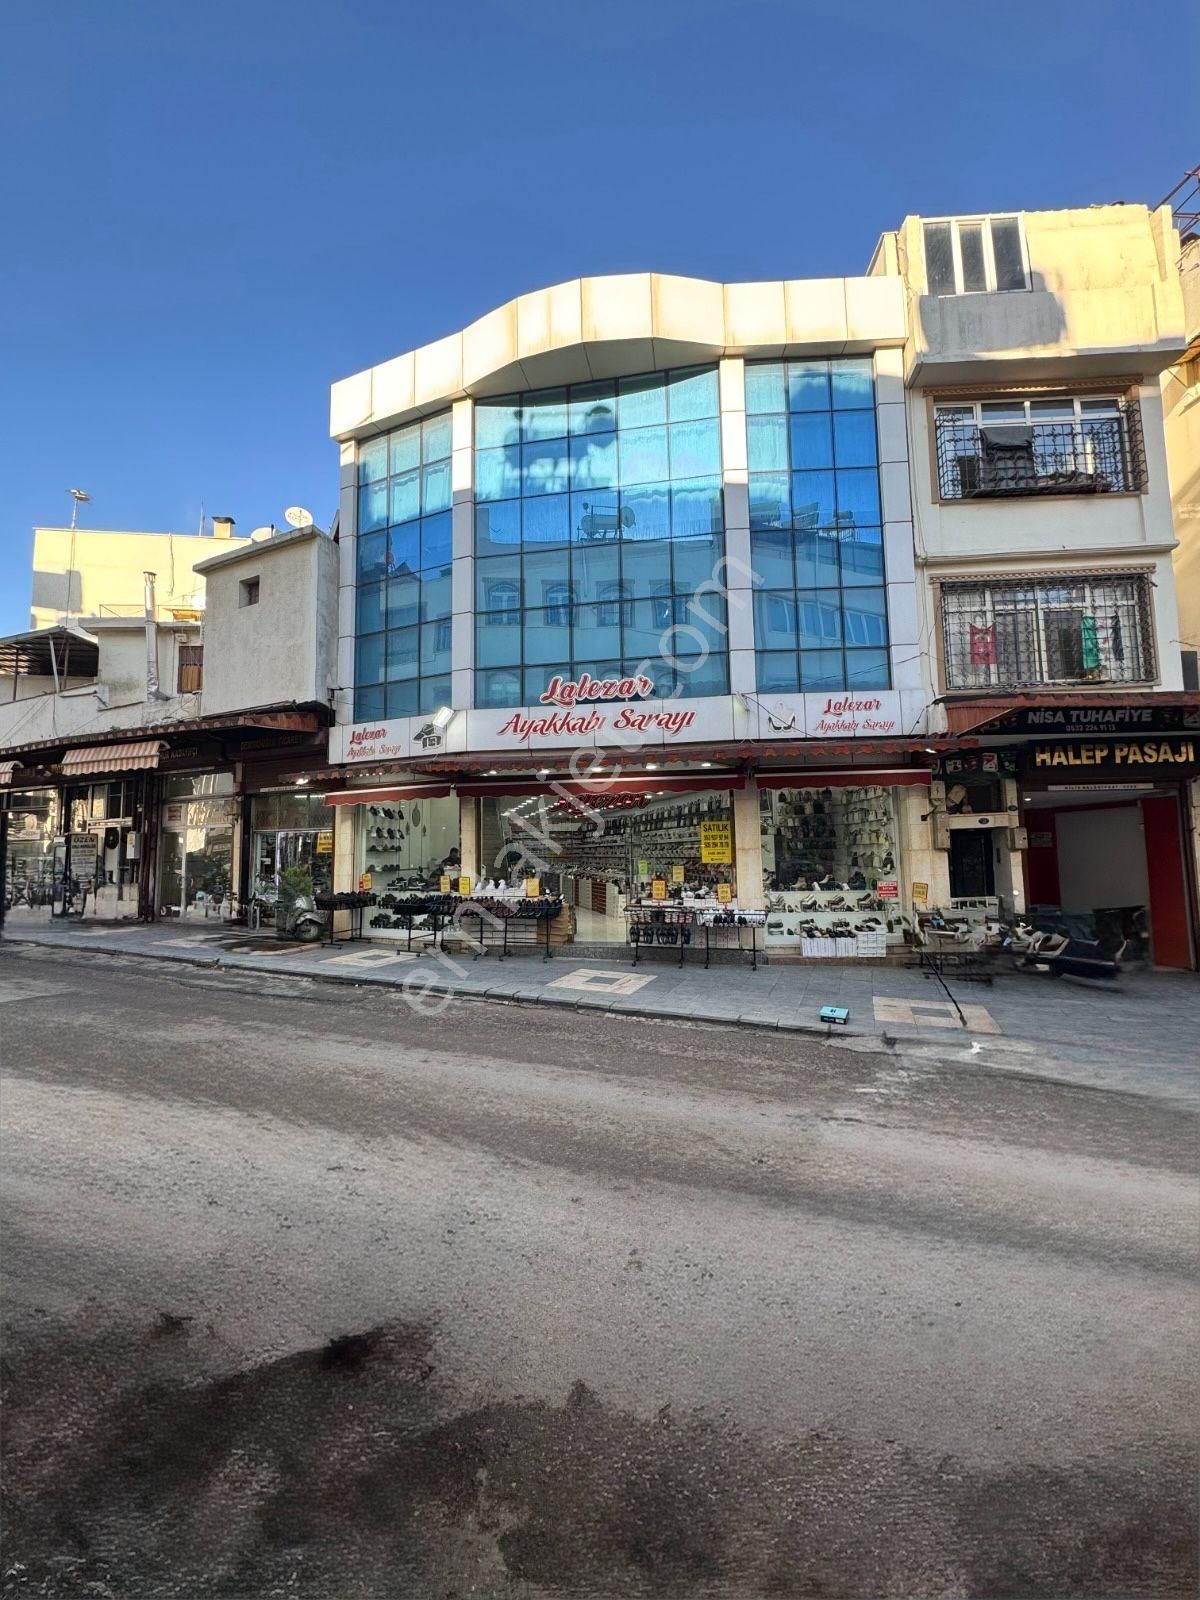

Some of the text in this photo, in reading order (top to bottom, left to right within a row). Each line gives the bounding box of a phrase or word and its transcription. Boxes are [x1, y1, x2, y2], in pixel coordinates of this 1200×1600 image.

[540, 673, 653, 708] Lalezar
[824, 697, 881, 716] Lalezar
[1027, 706, 1152, 724] NİSA TUHAFİYE
[497, 708, 696, 743] Ayakkabı Sarayı
[349, 727, 387, 746] Lalezar
[1035, 741, 1195, 767] HALEP PASAJI
[703, 823, 729, 833] SATILIK
